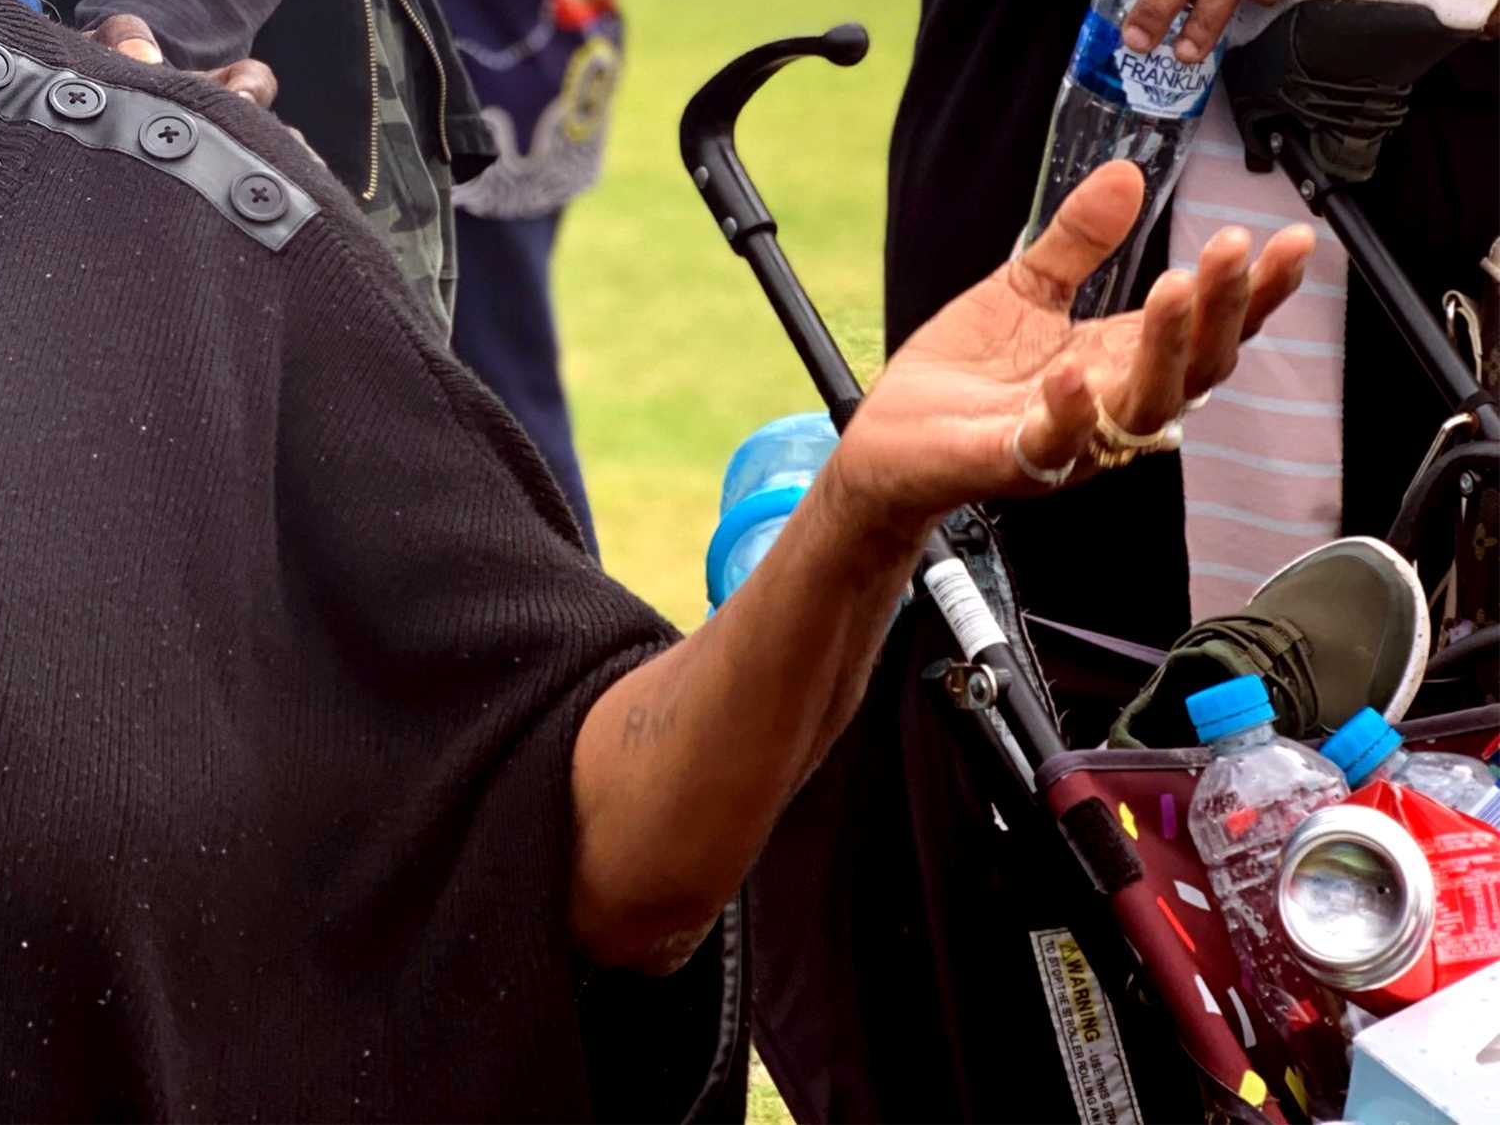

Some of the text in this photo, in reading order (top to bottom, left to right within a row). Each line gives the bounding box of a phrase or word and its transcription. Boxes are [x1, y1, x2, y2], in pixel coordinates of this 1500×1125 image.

[1119, 52, 1212, 91] FRANKLIN
[1045, 940, 1056, 954] TO
[1048, 956, 1065, 984] STOP
[1056, 984, 1070, 1006] THE
[1066, 958, 1101, 1043] WARNING
[1061, 1006, 1084, 1059] STROLLER
[1077, 1060, 1098, 1106] ROLLING
